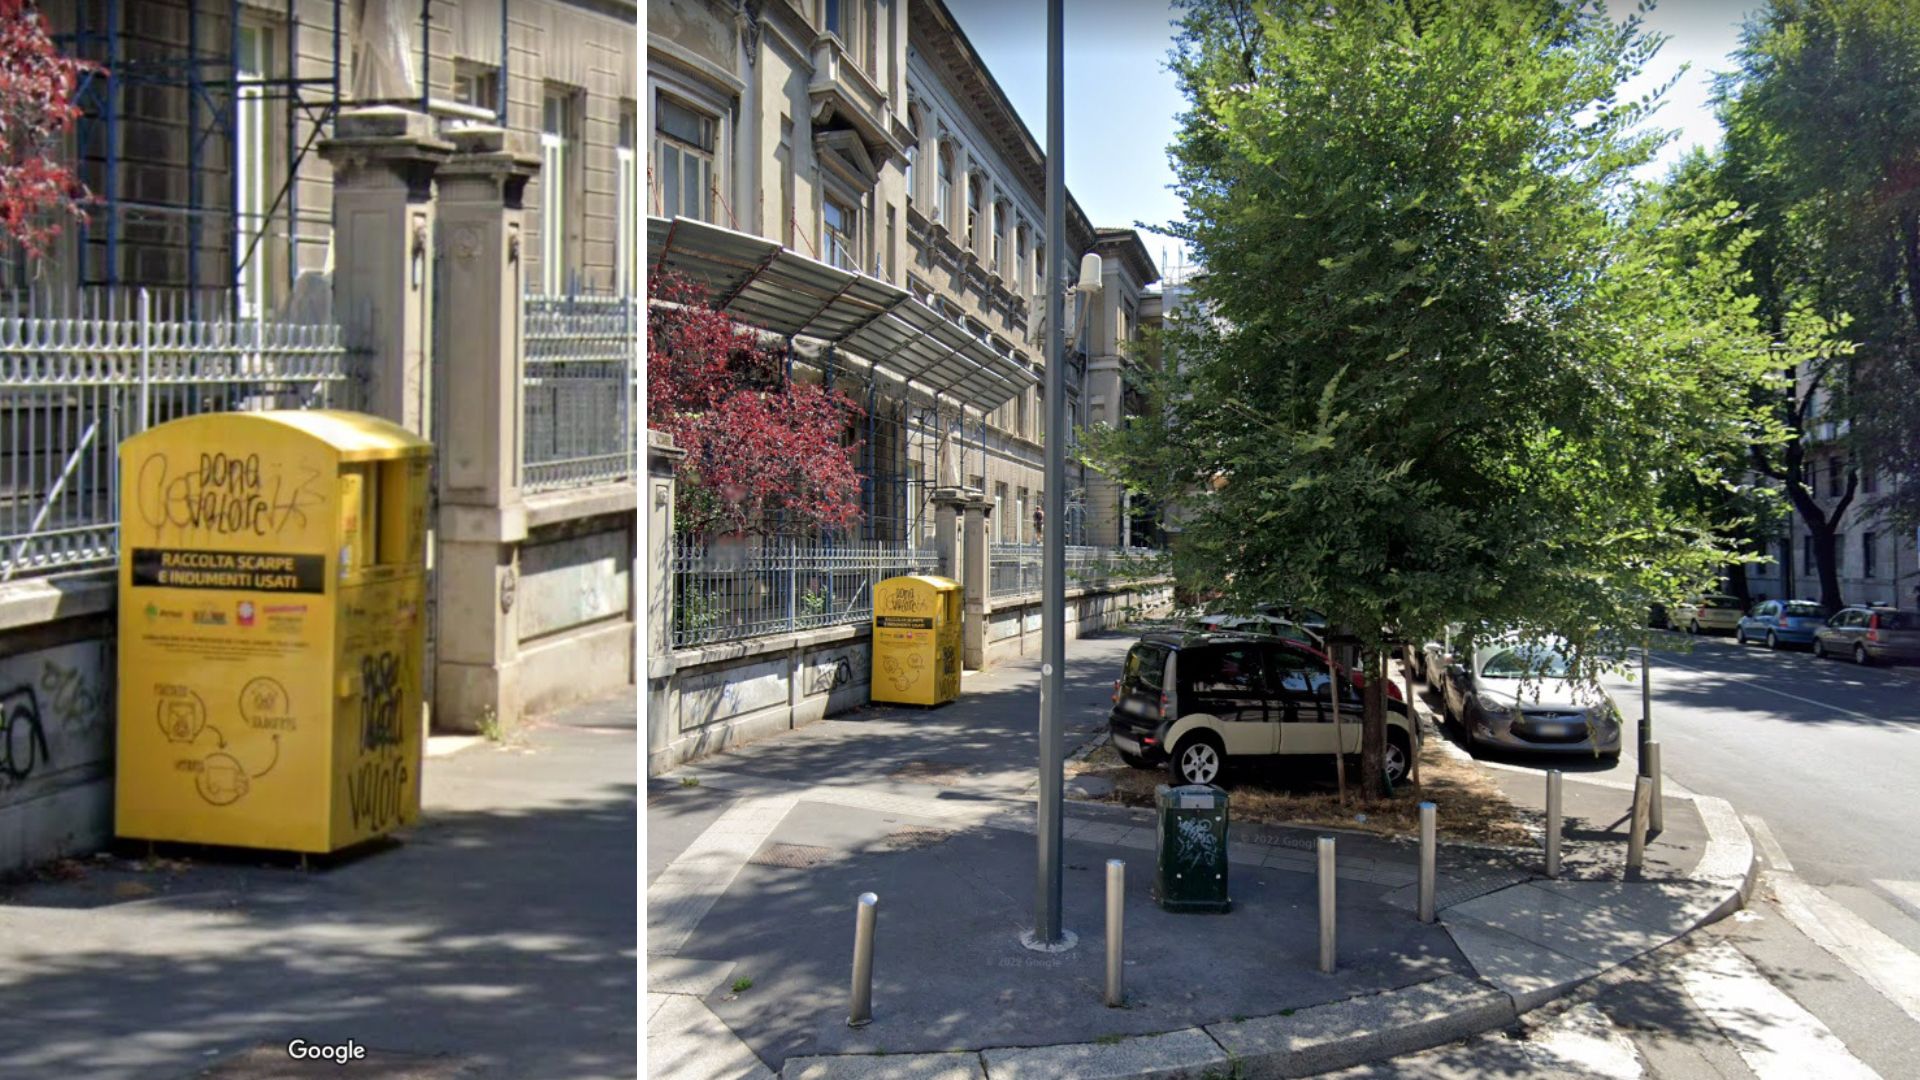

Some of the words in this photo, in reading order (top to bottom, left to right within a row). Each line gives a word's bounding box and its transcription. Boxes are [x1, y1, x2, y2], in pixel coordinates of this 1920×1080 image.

[162, 553, 234, 568] RACCOLTA
[237, 556, 294, 571] SCARPE
[158, 570, 167, 583] E
[170, 571, 252, 587] INDUMENTI
[254, 574, 297, 588] USATI
